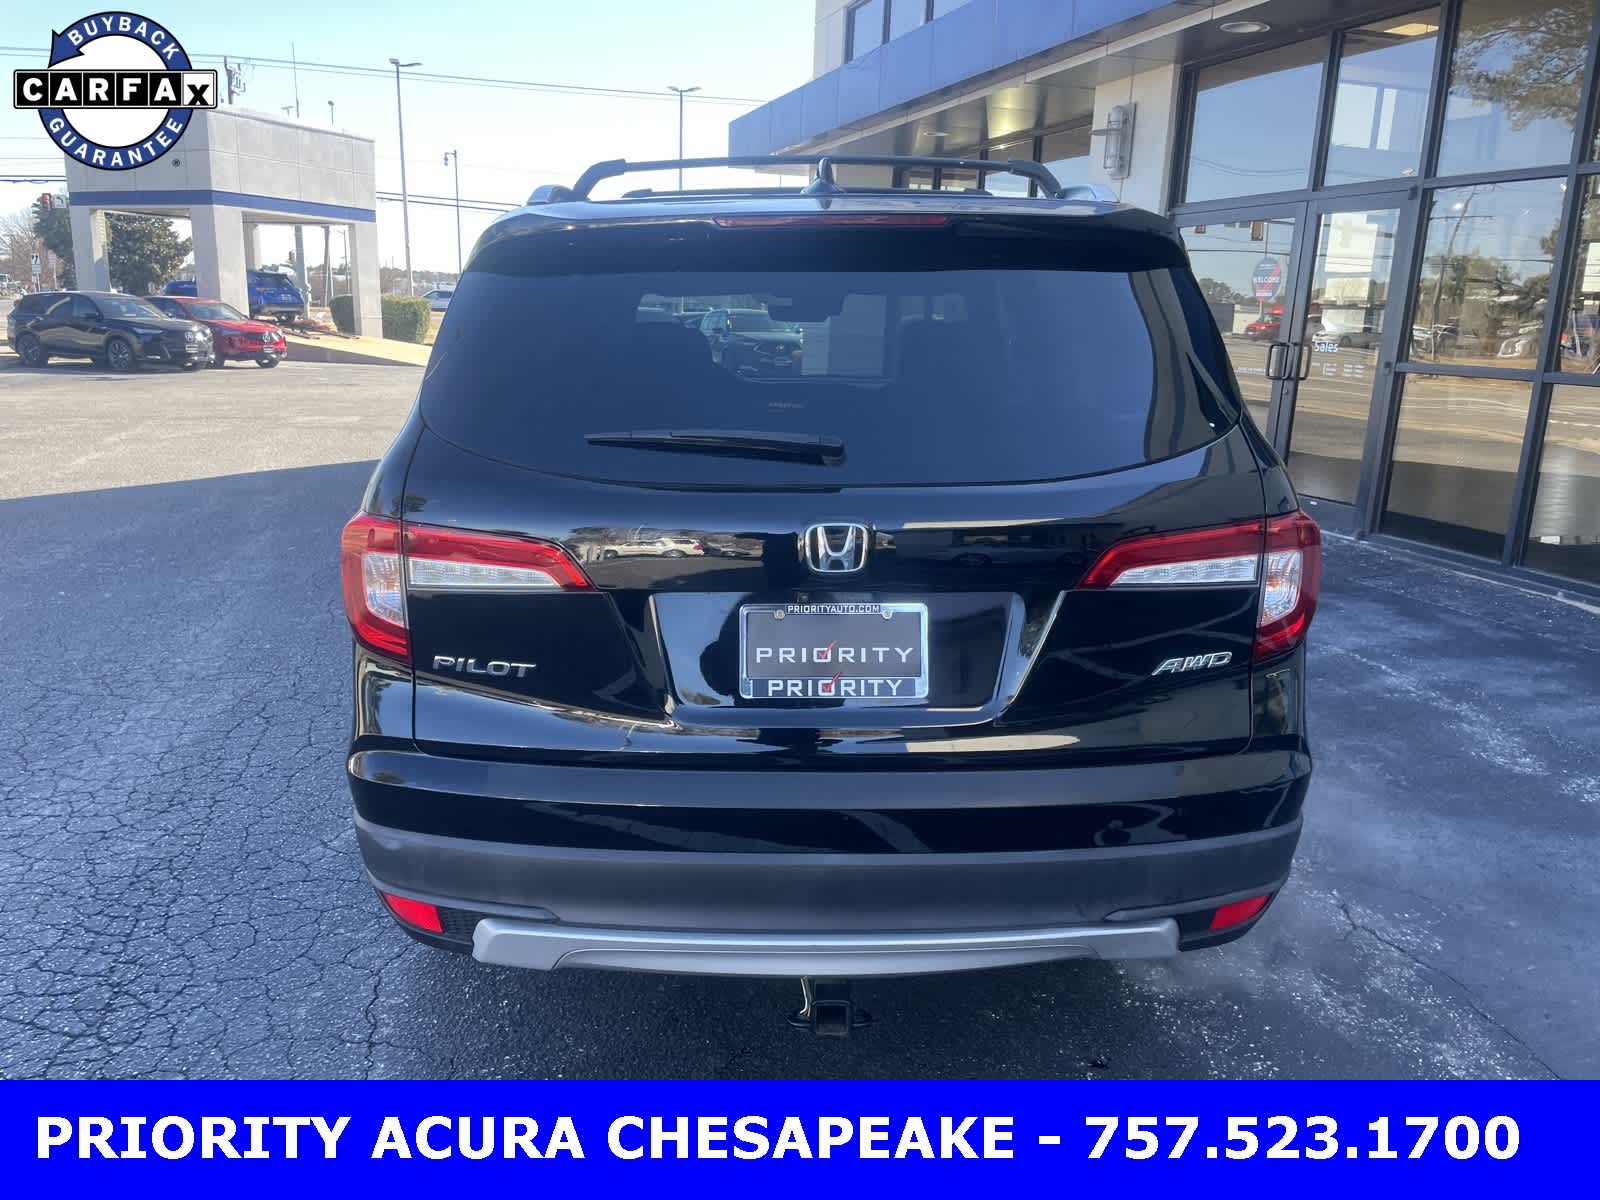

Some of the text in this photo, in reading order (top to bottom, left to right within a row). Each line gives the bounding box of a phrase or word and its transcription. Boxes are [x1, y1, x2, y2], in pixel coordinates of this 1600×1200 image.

[1314, 341, 1338, 353] Sales
[787, 604, 881, 614] PRIORITYAUTO.COM
[755, 647, 914, 664] PRIORITY
[1151, 651, 1233, 676] AWD
[432, 655, 537, 678] PILOT
[767, 679, 903, 697] PRIORITY
